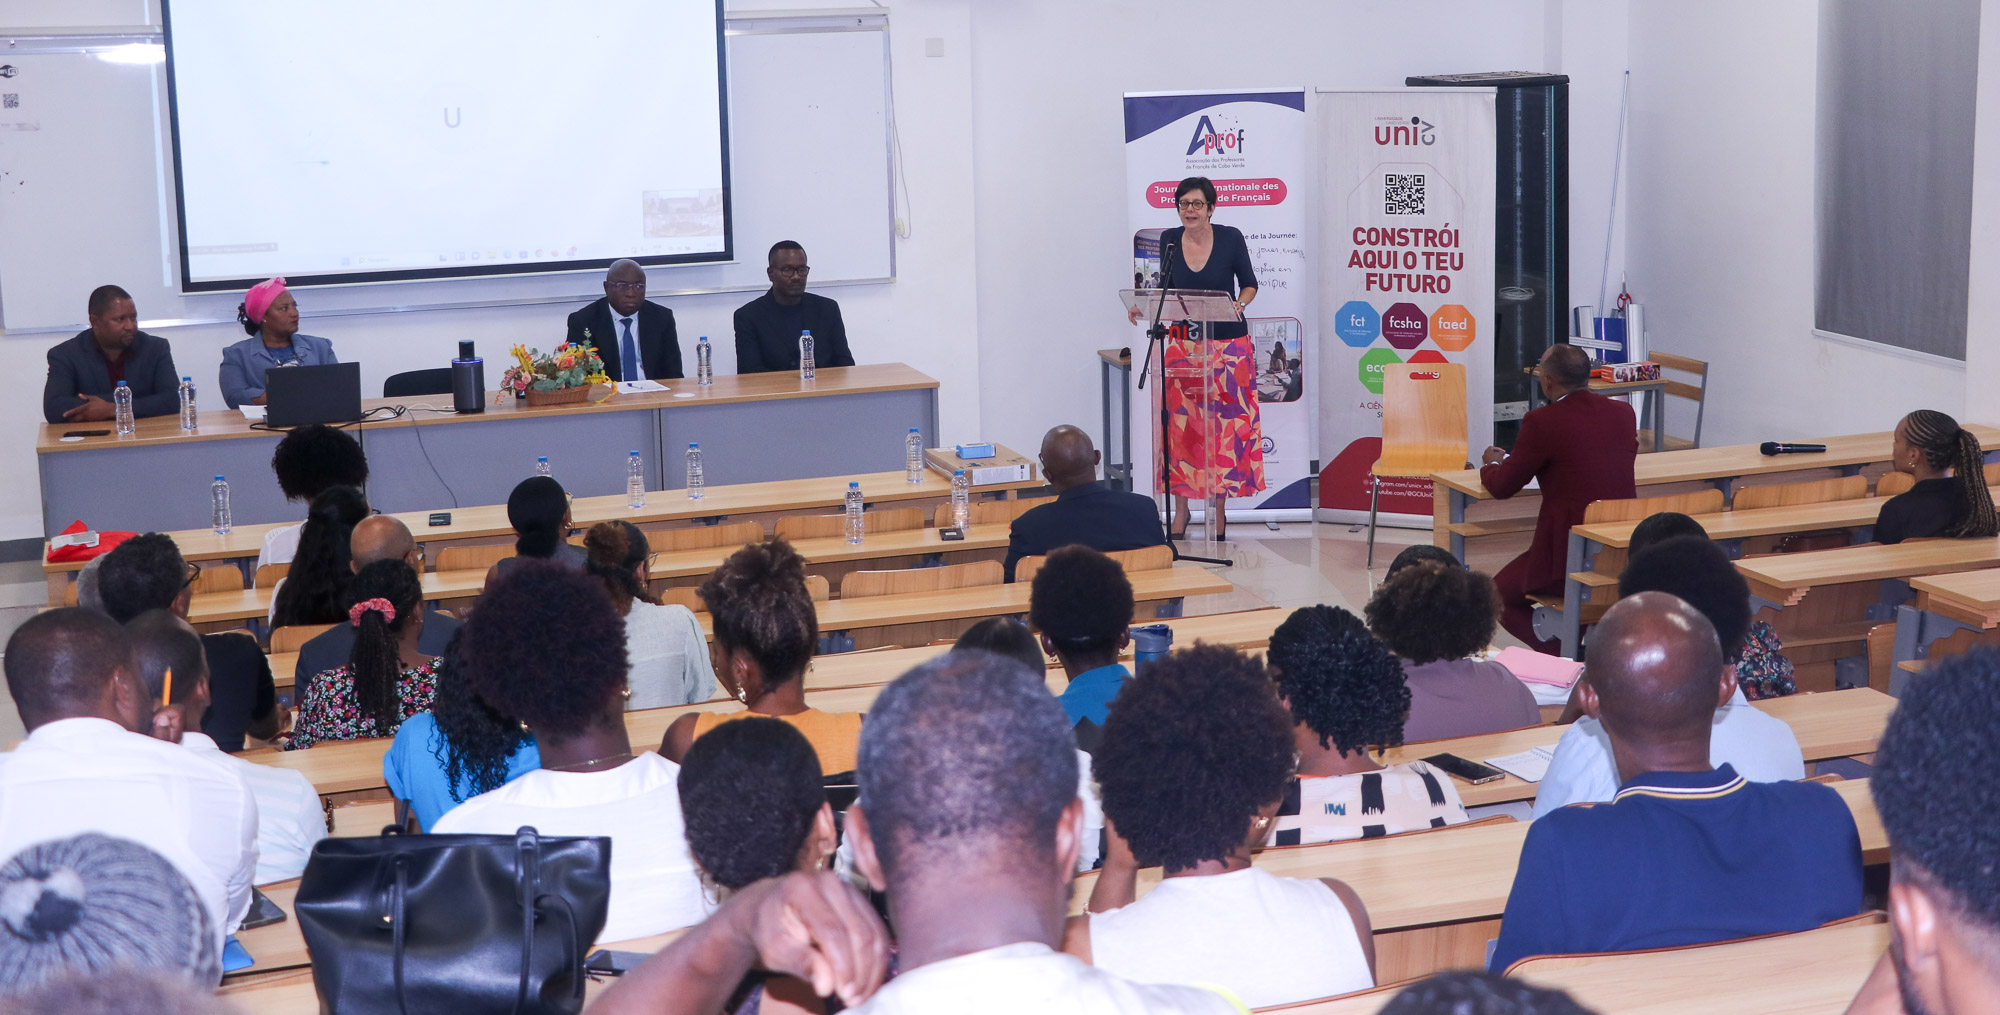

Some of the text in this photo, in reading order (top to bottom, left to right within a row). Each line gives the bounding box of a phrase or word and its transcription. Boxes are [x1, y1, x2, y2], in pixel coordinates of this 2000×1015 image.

[443, 106, 461, 128] U
[1375, 116, 1420, 146] uni
[1262, 182, 1279, 190] des
[1217, 194, 1230, 202] de
[1231, 192, 1271, 203] Français
[1352, 223, 1459, 248] CONSTRÓI
[1347, 249, 1464, 271] AQUI O TEU
[1365, 272, 1451, 294] FUTURO
[1350, 314, 1366, 327] fct
[1389, 315, 1422, 329] fcsha
[1438, 316, 1468, 330] faed
